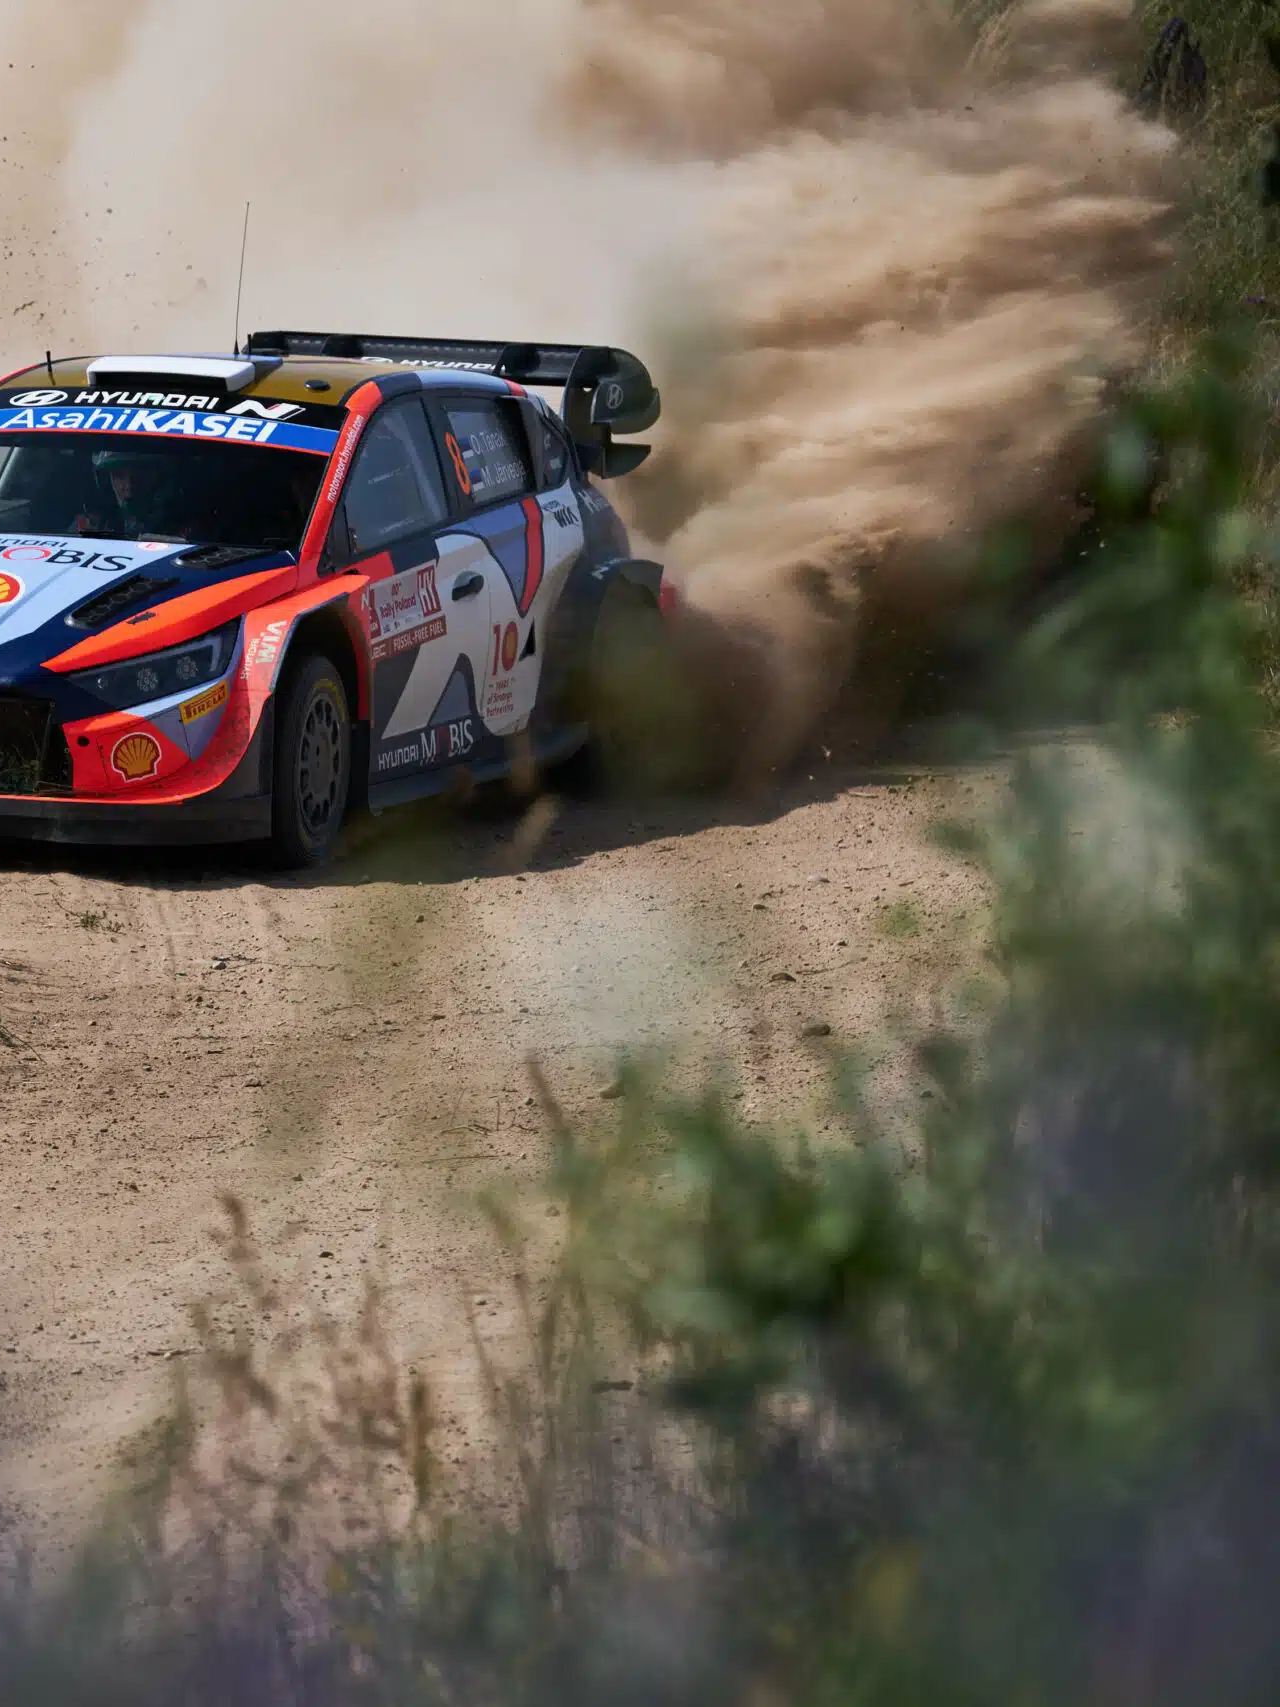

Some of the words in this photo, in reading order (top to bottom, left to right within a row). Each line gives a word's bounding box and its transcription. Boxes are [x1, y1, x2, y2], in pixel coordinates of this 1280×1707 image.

[401, 359, 506, 372] HYUND
[74, 390, 219, 410] HYUNDAI
[327, 413, 364, 503] motorsport.hyundai.com
[444, 431, 471, 495] 8
[395, 593, 417, 612] Poland
[240, 638, 261, 680] HYUNDAI
[378, 744, 419, 772] HYUNDAI
